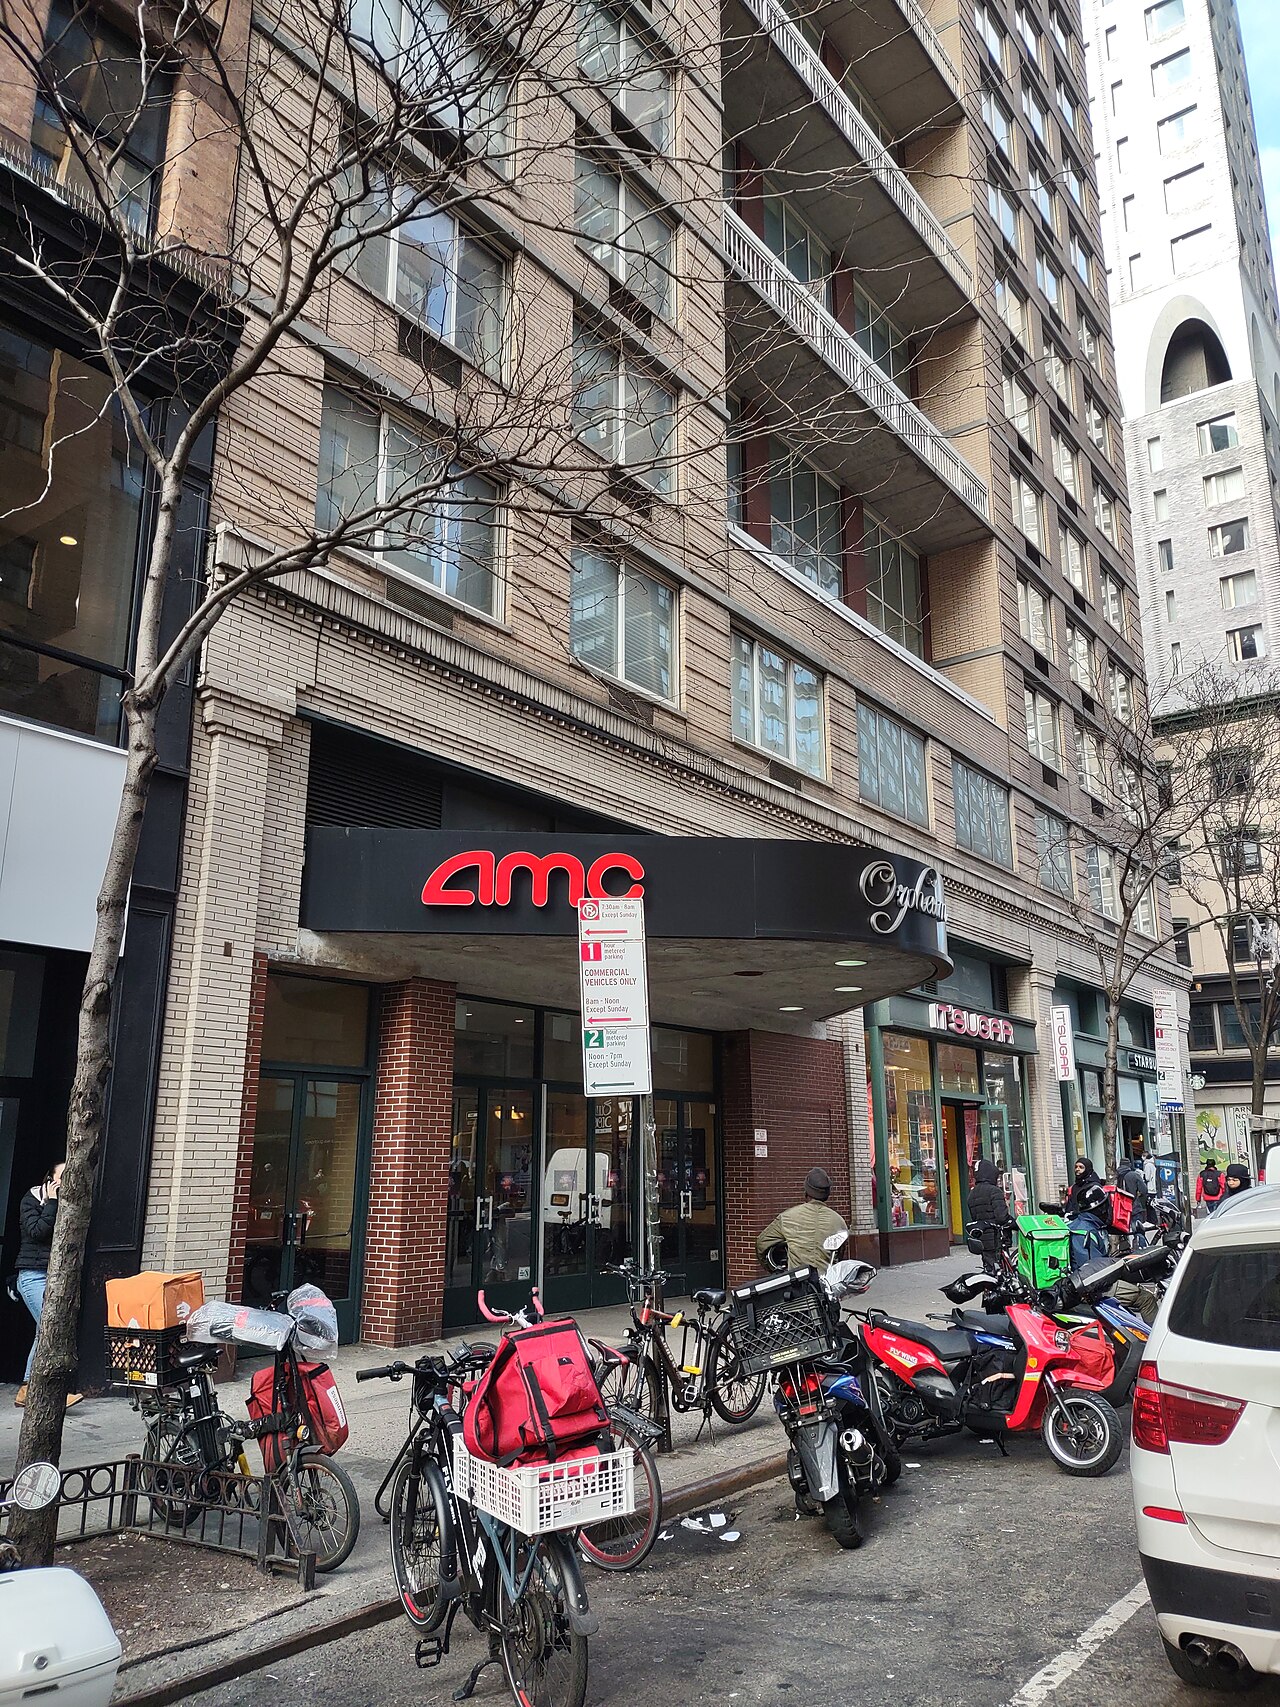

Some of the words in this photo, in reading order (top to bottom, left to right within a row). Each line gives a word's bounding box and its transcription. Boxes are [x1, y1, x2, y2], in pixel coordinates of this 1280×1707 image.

[601, 911, 619, 919] Except
[620, 911, 638, 919] Sunday
[587, 943, 595, 960] 1
[584, 968, 630, 977] COMMERCIAL
[584, 978, 618, 987] VEHICLES
[619, 977, 637, 986] ONLY
[585, 997, 600, 1005] 8am
[585, 1006, 606, 1014] Except
[607, 1005, 629, 1013] Sunday
[929, 1003, 1015, 1045] IT'SUGAR
[588, 1030, 600, 1047] 2
[1055, 1011, 1070, 1078] IT'SUGAR
[610, 1052, 623, 1060] 7pm
[588, 1061, 609, 1069] Except
[610, 1060, 632, 1068] Sunday
[890, 1346, 902, 1357] FLY
[901, 1351, 918, 1363] WING
[442, 1465, 456, 1493] FLY
